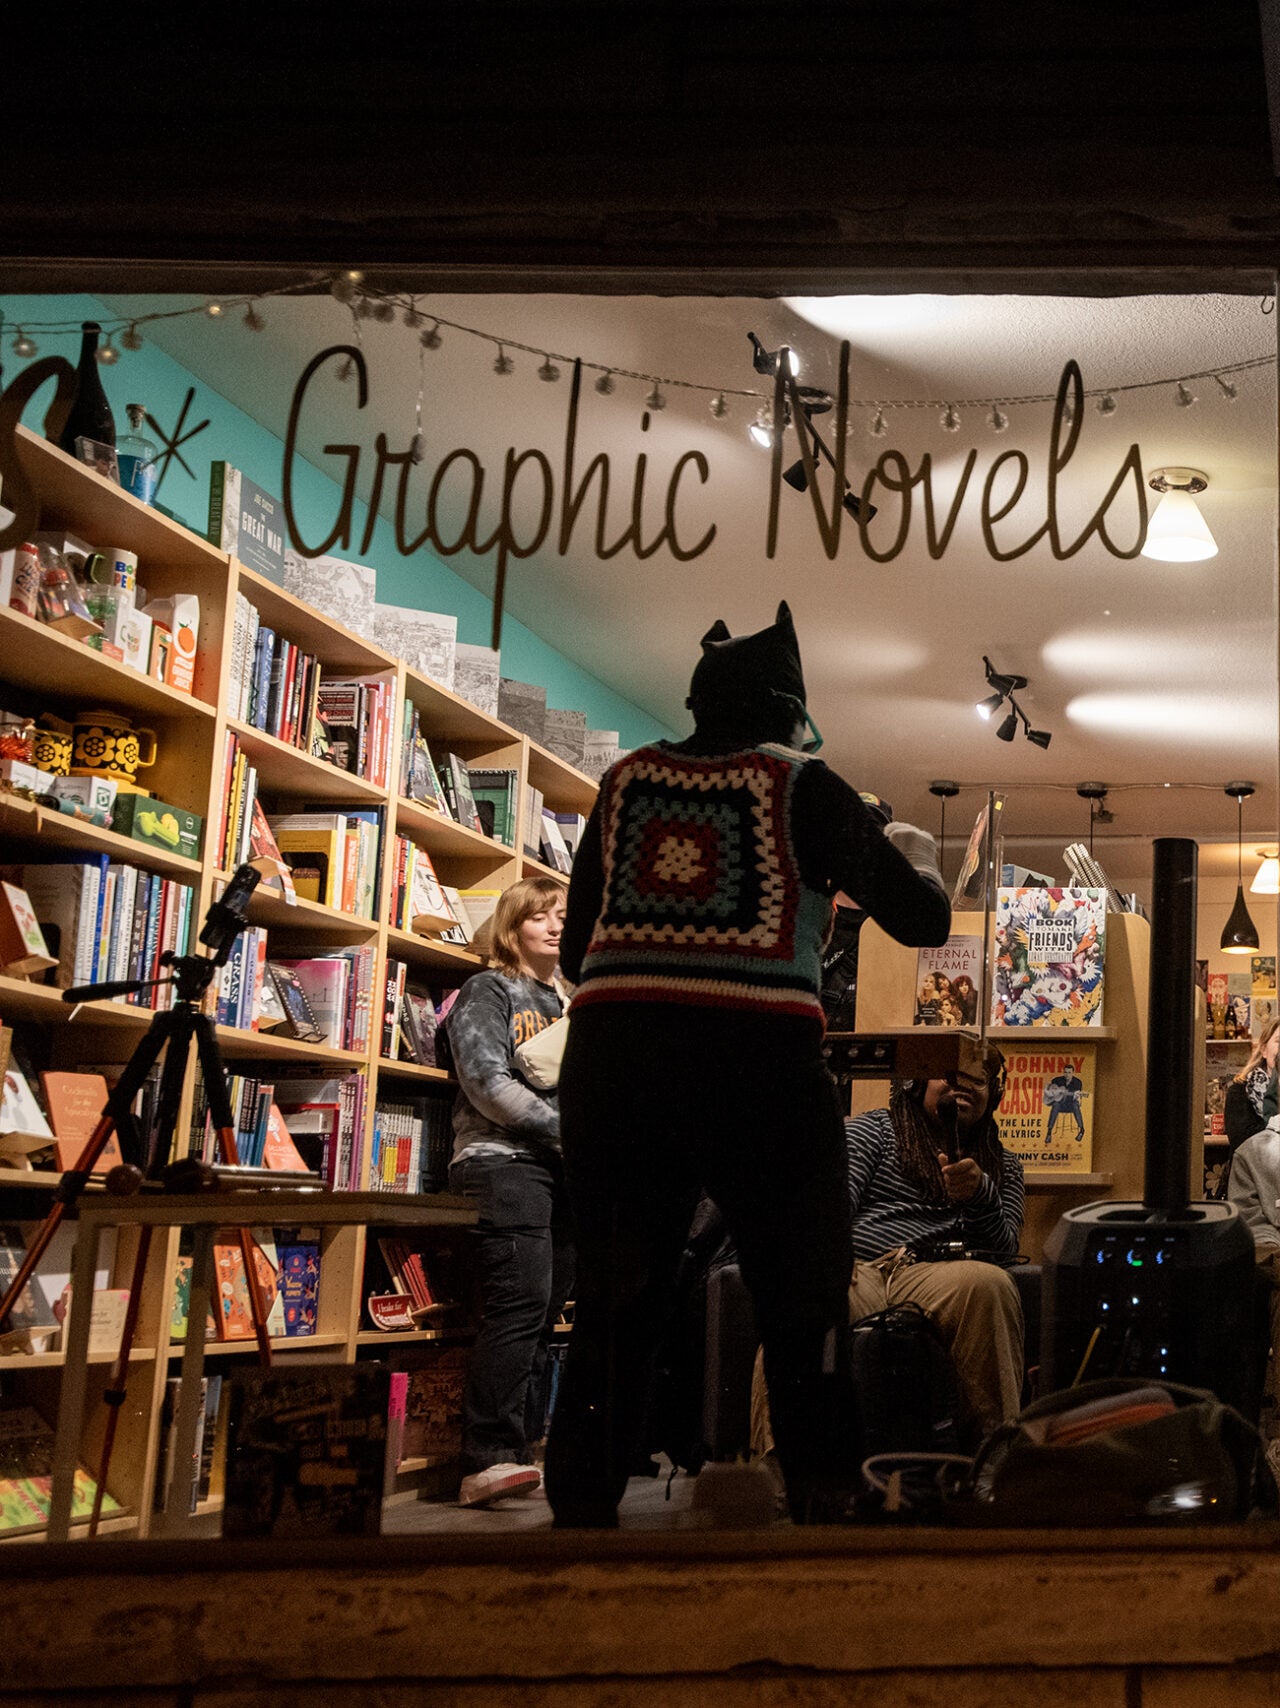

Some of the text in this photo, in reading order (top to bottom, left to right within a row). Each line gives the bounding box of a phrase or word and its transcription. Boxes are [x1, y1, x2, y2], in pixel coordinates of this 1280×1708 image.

[282, 344, 718, 651] Graphic
[766, 339, 1148, 563] Novels
[242, 510, 282, 556] GREAT WAR
[1029, 932, 1073, 951] FRIENDS
[922, 948, 977, 959] ETERNAL
[928, 960, 969, 970] FLAME
[230, 952, 242, 1004] GRASS
[1006, 1056, 1085, 1074] JOHNNY
[1000, 1076, 1044, 1115] CASH
[1000, 1119, 1042, 1127] THE LIFE
[1000, 1130, 1041, 1138] IN LYRICS
[1041, 1153, 1069, 1161] CASH
